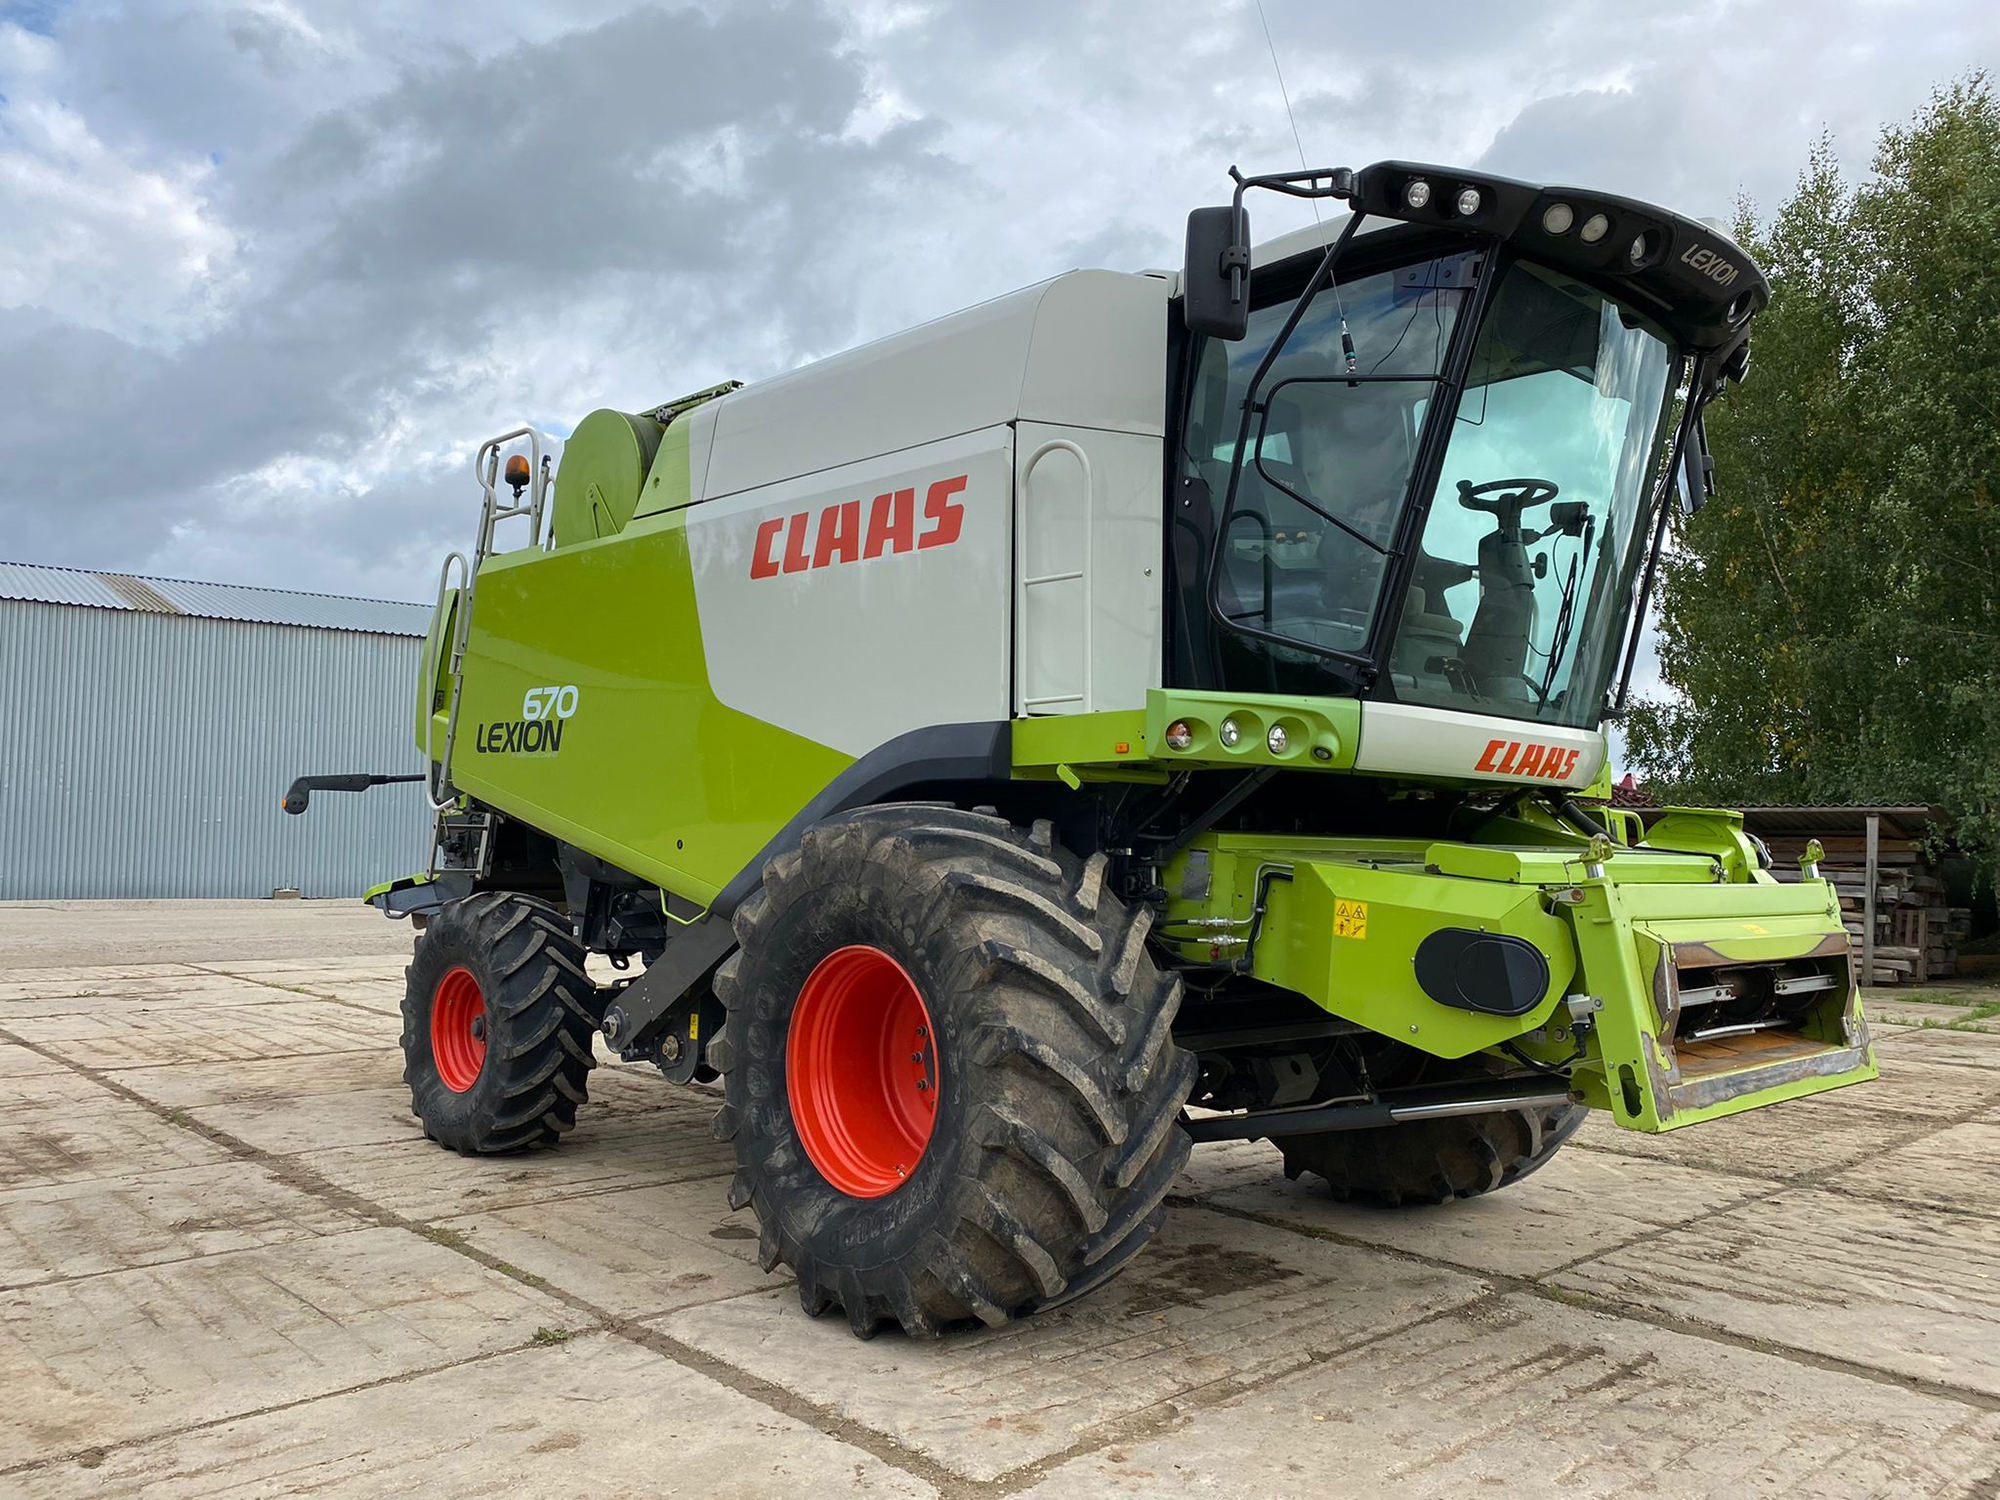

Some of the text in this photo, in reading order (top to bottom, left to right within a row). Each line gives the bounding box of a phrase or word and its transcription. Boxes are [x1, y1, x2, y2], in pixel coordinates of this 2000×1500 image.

[1681, 243, 1739, 286] LEXION
[750, 475, 967, 579] CLAAS
[523, 685, 579, 719] 670
[476, 720, 563, 753] LEXION
[1474, 740, 1580, 779] CLAAS
